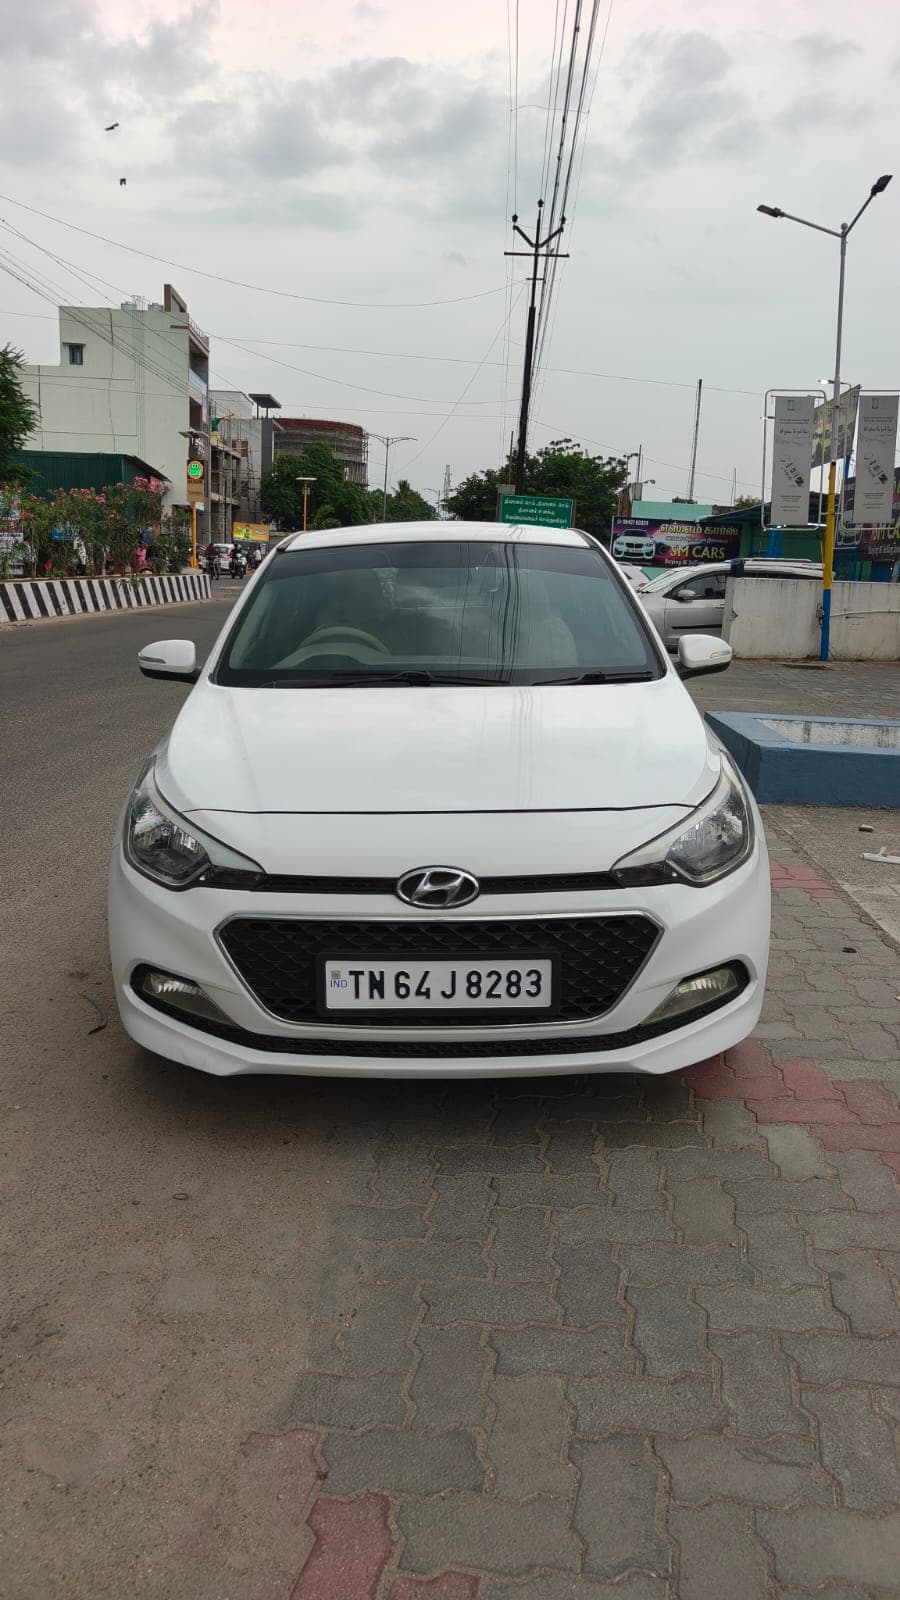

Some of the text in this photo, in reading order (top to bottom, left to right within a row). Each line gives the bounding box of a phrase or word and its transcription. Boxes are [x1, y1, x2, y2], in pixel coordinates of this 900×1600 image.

[671, 544, 726, 559] SM CARS
[330, 969, 542, 999] IND TN 64 J 8283
